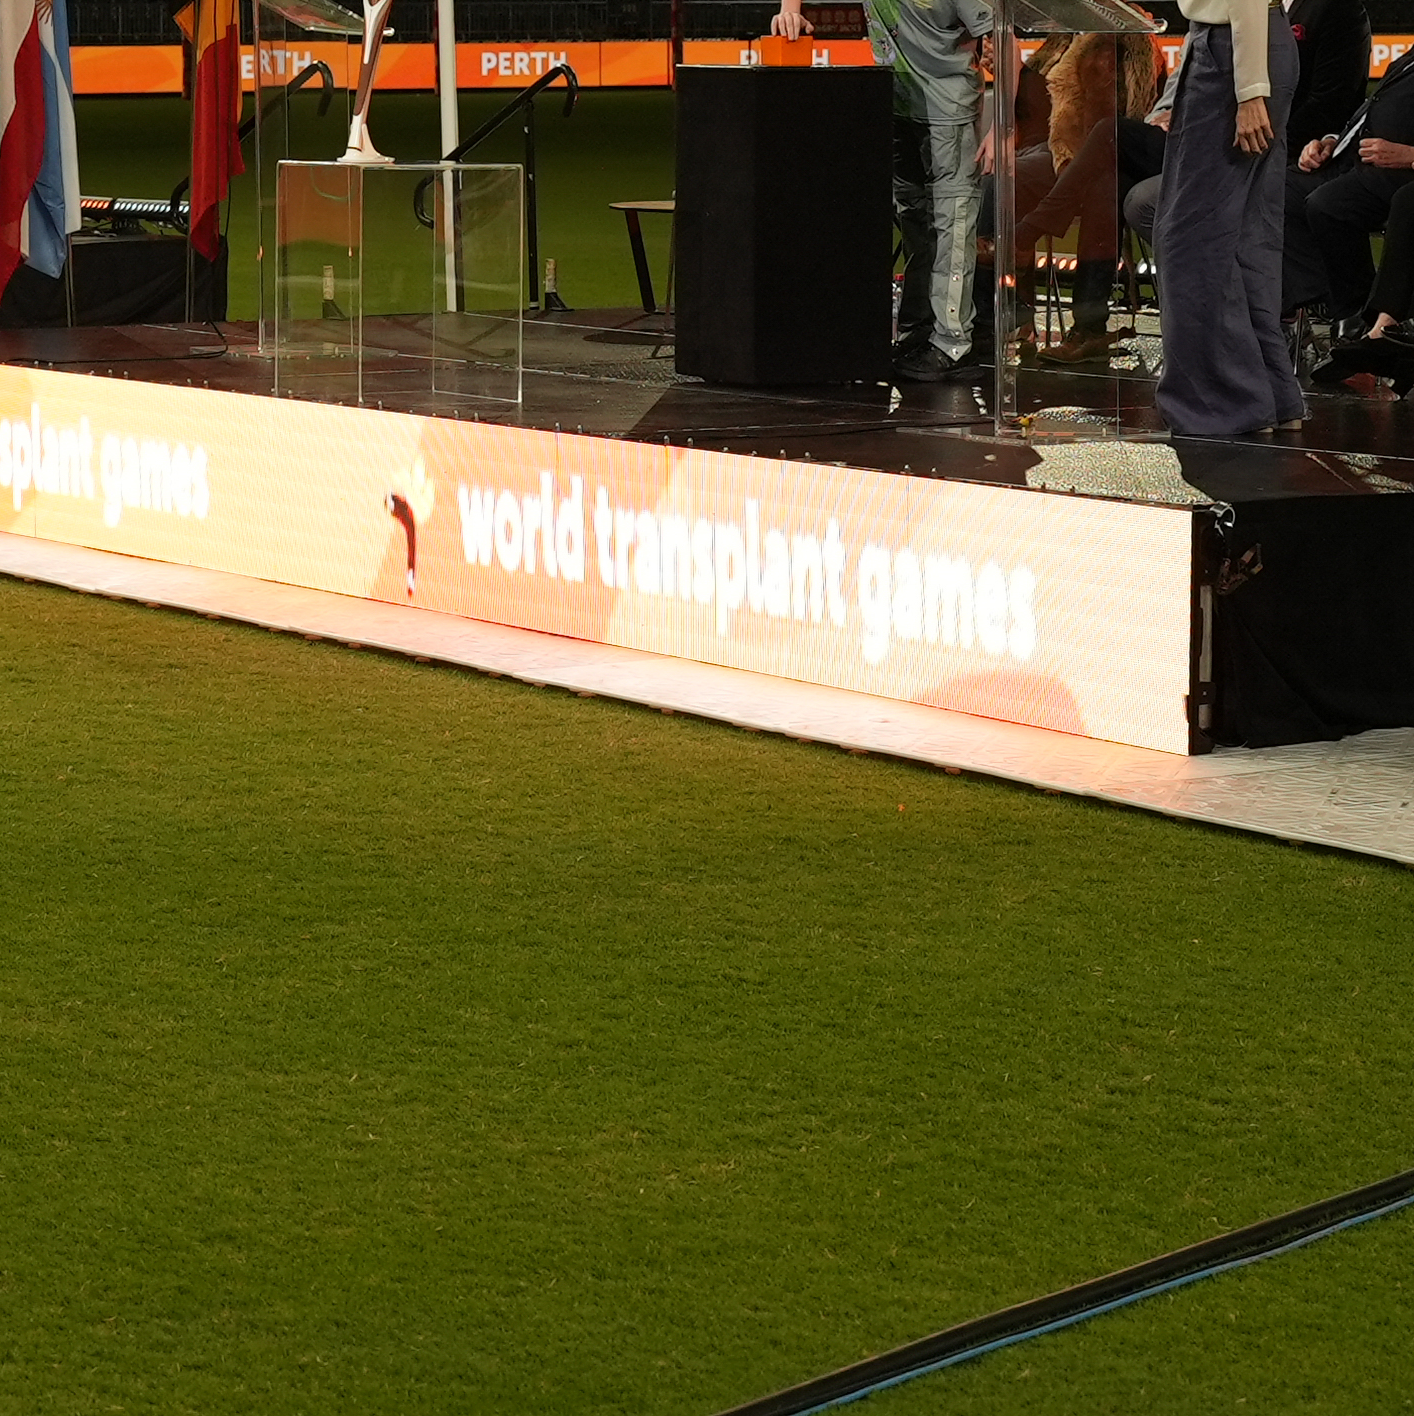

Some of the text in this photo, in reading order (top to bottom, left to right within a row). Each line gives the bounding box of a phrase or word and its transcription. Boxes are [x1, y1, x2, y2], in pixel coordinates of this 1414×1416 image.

[240, 48, 312, 79] ERTH
[481, 51, 567, 76] PERTH
[100, 430, 209, 527] games
[457, 469, 1037, 664] world transplant games
